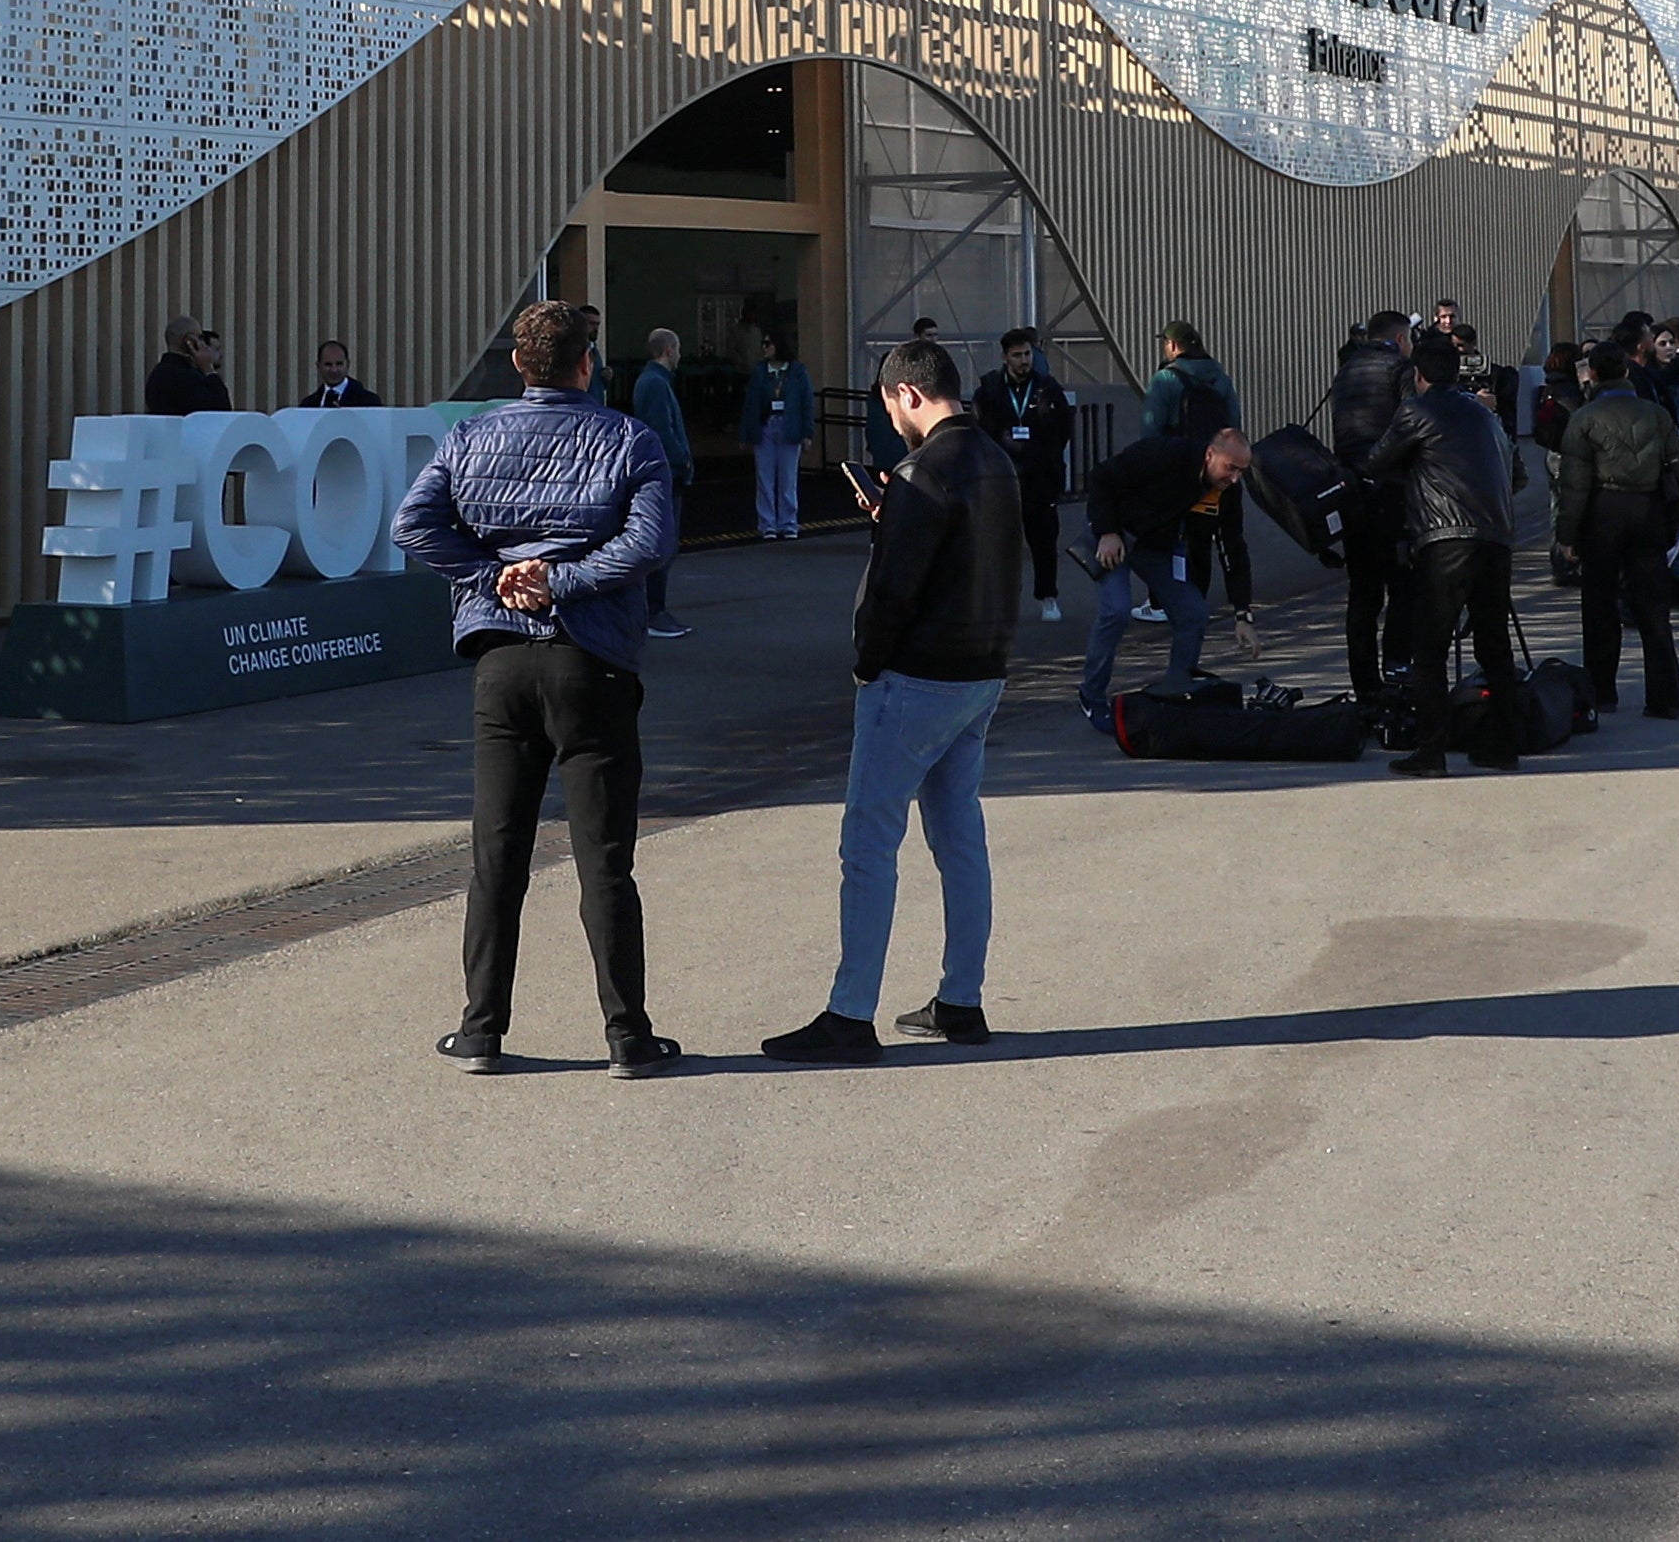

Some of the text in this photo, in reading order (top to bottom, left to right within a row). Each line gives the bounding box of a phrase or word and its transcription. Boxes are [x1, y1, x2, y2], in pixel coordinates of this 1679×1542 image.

[1307, 27, 1388, 83] Entrance
[223, 616, 309, 646] UN CLIMATE
[228, 633, 382, 675] CHANGE CONFERENCE
